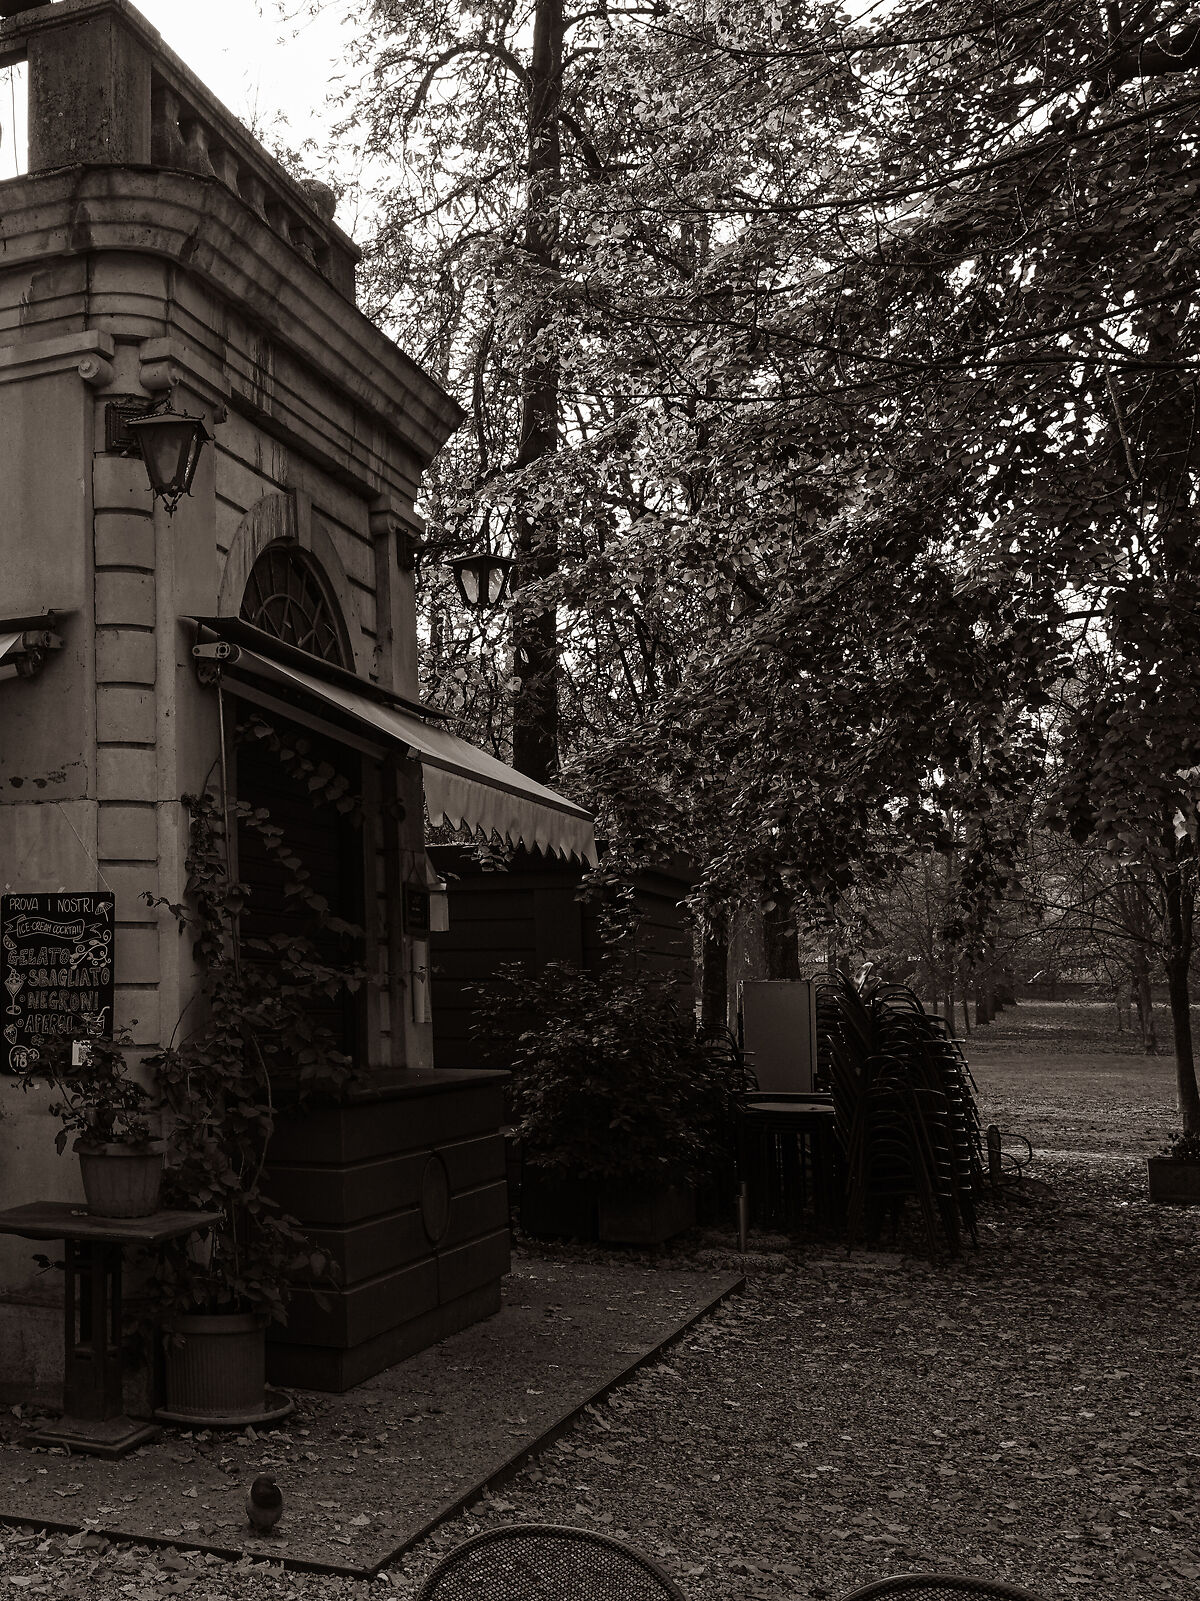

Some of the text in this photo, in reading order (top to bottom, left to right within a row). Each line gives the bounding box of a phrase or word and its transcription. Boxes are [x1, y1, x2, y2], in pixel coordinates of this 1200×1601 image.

[9, 897, 94, 913] PROVA I NOSTRI
[7, 946, 71, 966] GELATO
[27, 967, 111, 987] SBAGLIATO
[27, 989, 99, 1011] NEGRONI
